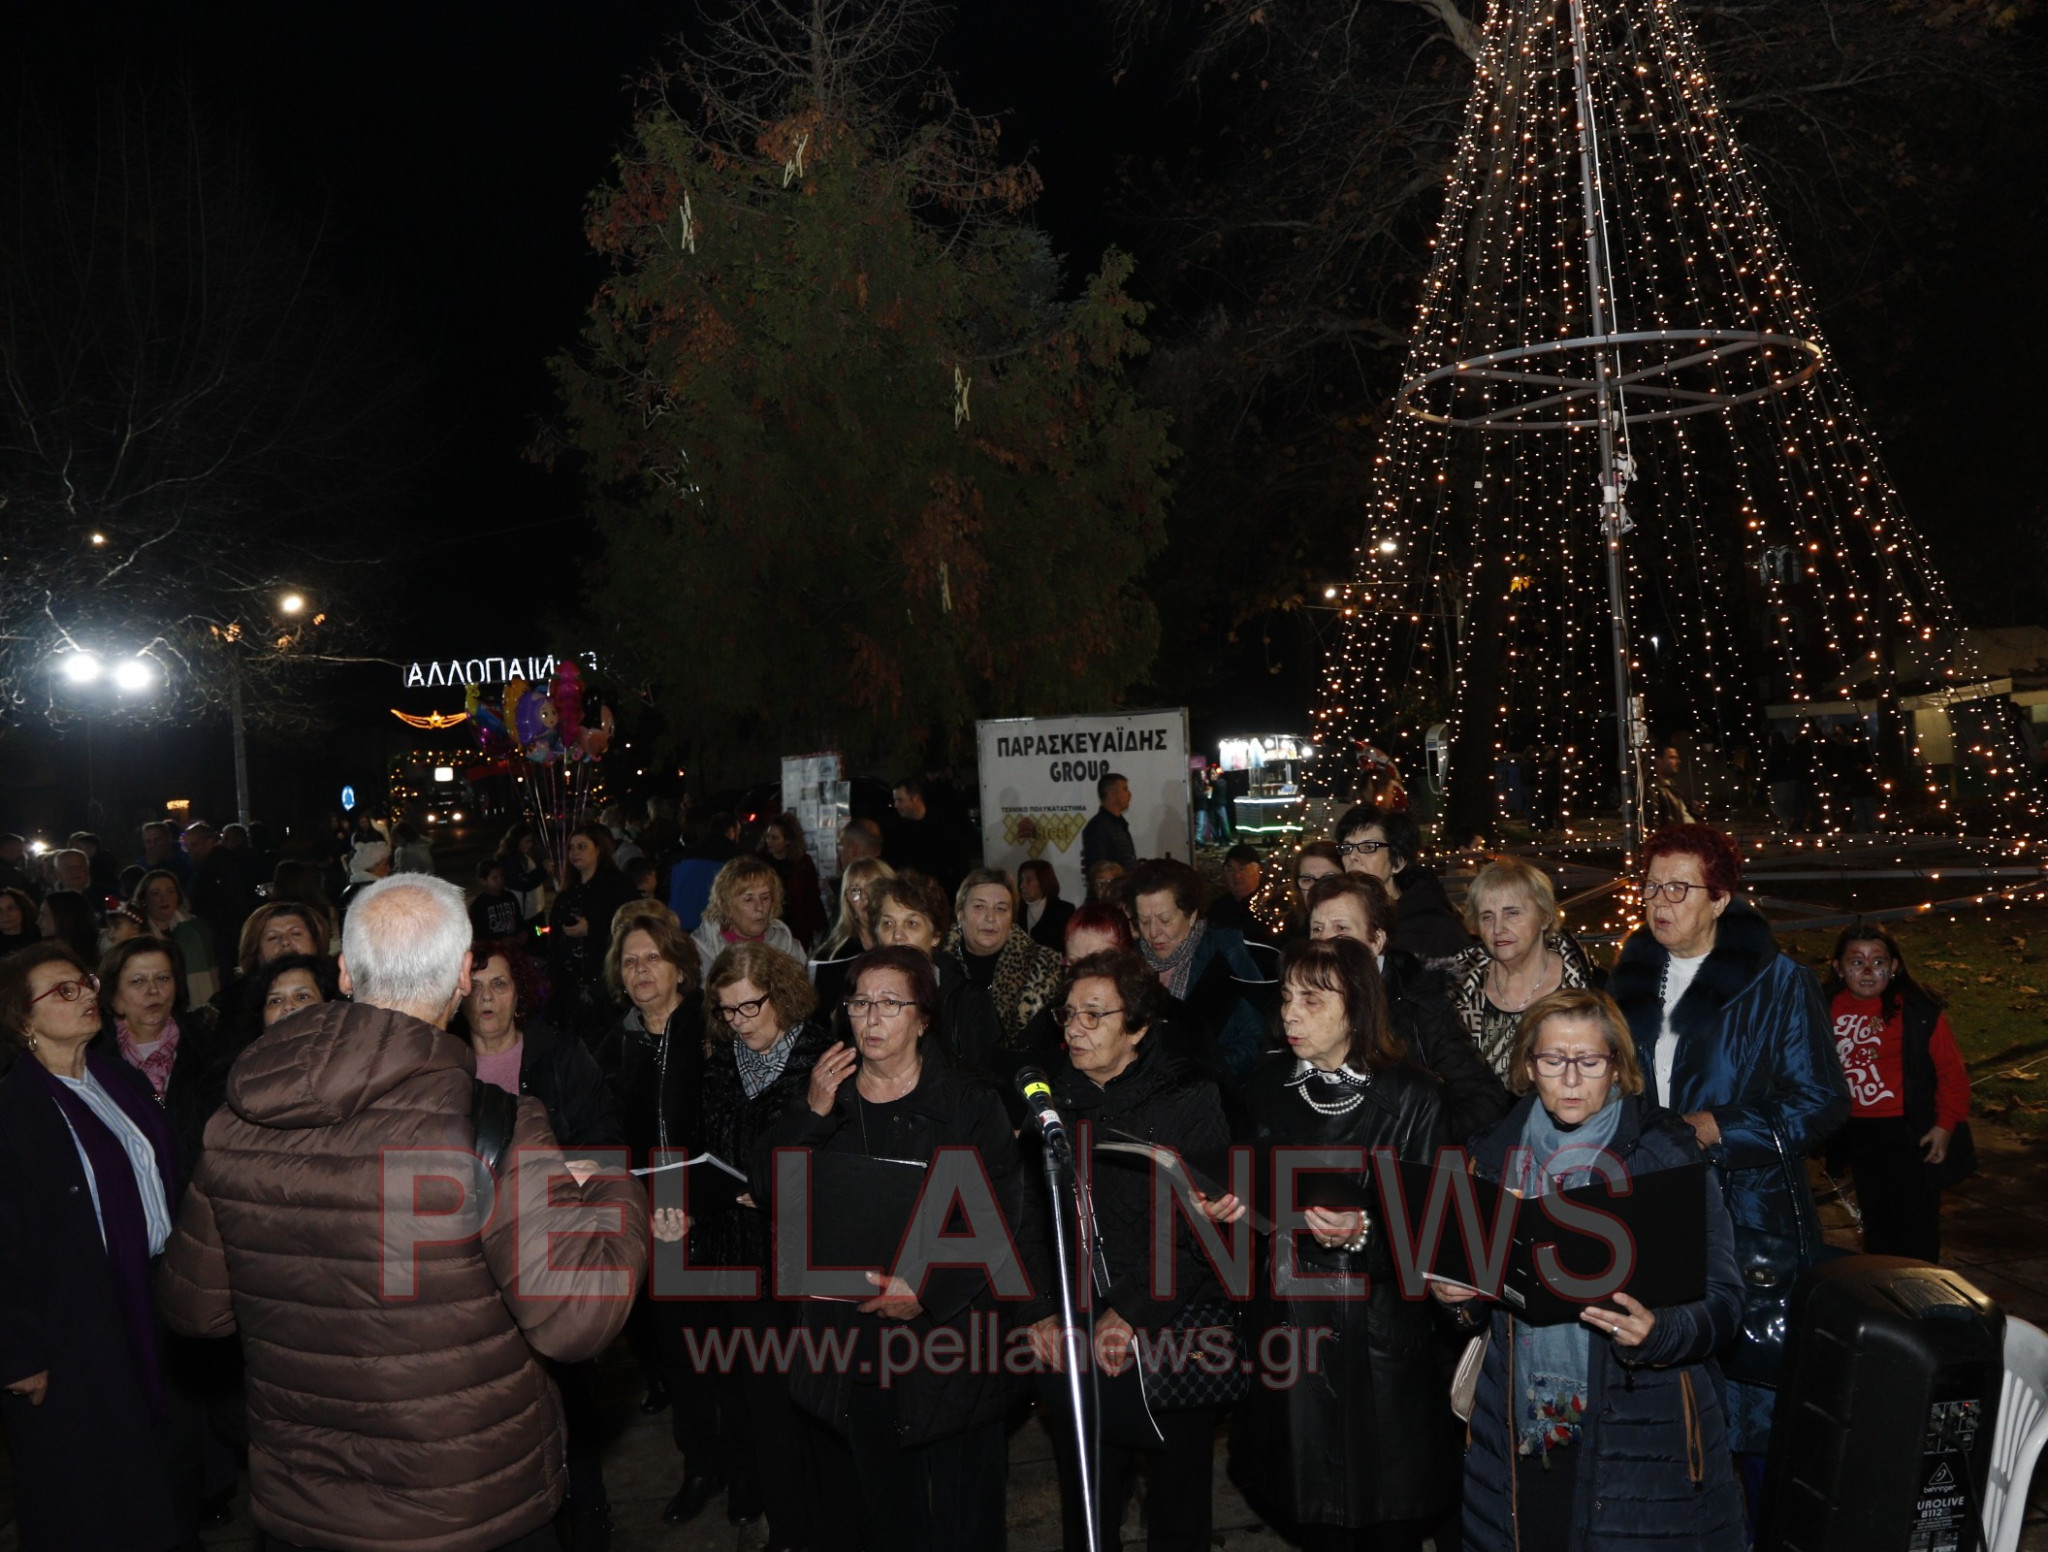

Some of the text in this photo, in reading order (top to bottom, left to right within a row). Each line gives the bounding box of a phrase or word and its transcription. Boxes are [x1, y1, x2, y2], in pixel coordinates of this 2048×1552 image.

[997, 727, 1168, 758] ΠΑΡΑΣΚΕΥΑΪΔΗΣ
[1050, 760, 1110, 783] GROUP
[1834, 1014, 1882, 1046] Ho
[1917, 1496, 1965, 1510] UROLIVE
